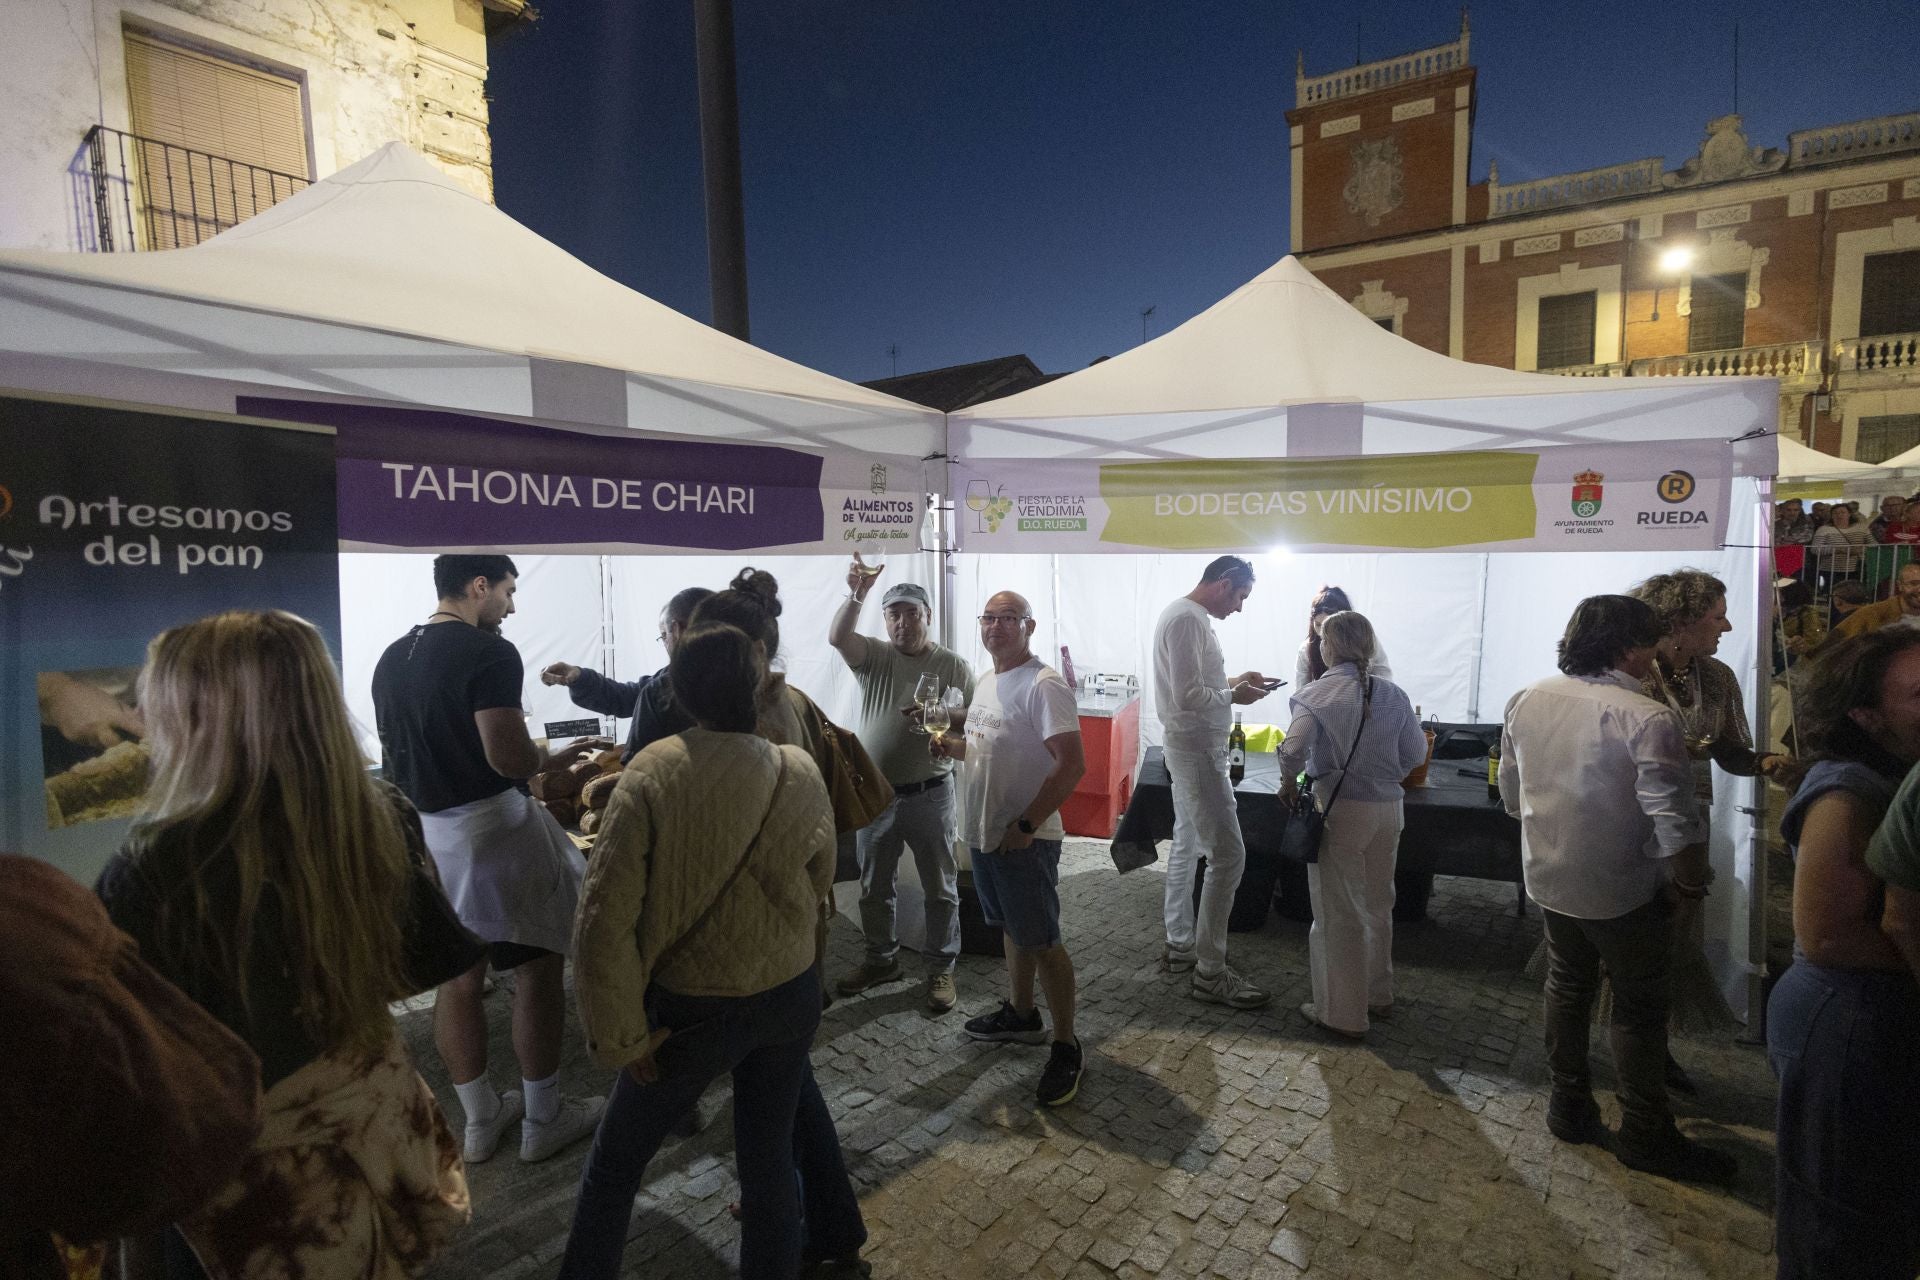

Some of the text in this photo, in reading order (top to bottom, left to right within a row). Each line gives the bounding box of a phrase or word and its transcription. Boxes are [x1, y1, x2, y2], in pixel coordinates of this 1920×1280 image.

[382, 463, 754, 514] TAHONA DE CHARI
[1668, 478, 1684, 494] R
[843, 497, 913, 512] ALIMENTOS
[1018, 496, 1085, 504] FIESTA DE LA
[1155, 483, 1472, 516] BODEGAS VINÍSIMO
[38, 495, 292, 533] Artesanos
[858, 512, 913, 523] VALLADOLID
[1018, 506, 1084, 516] VENDIMIA
[1637, 511, 1709, 525] RUEDA
[1023, 520, 1081, 529] D.O. RUEDA
[843, 528, 909, 542] A gusto de todos
[84, 535, 264, 574] del pan
